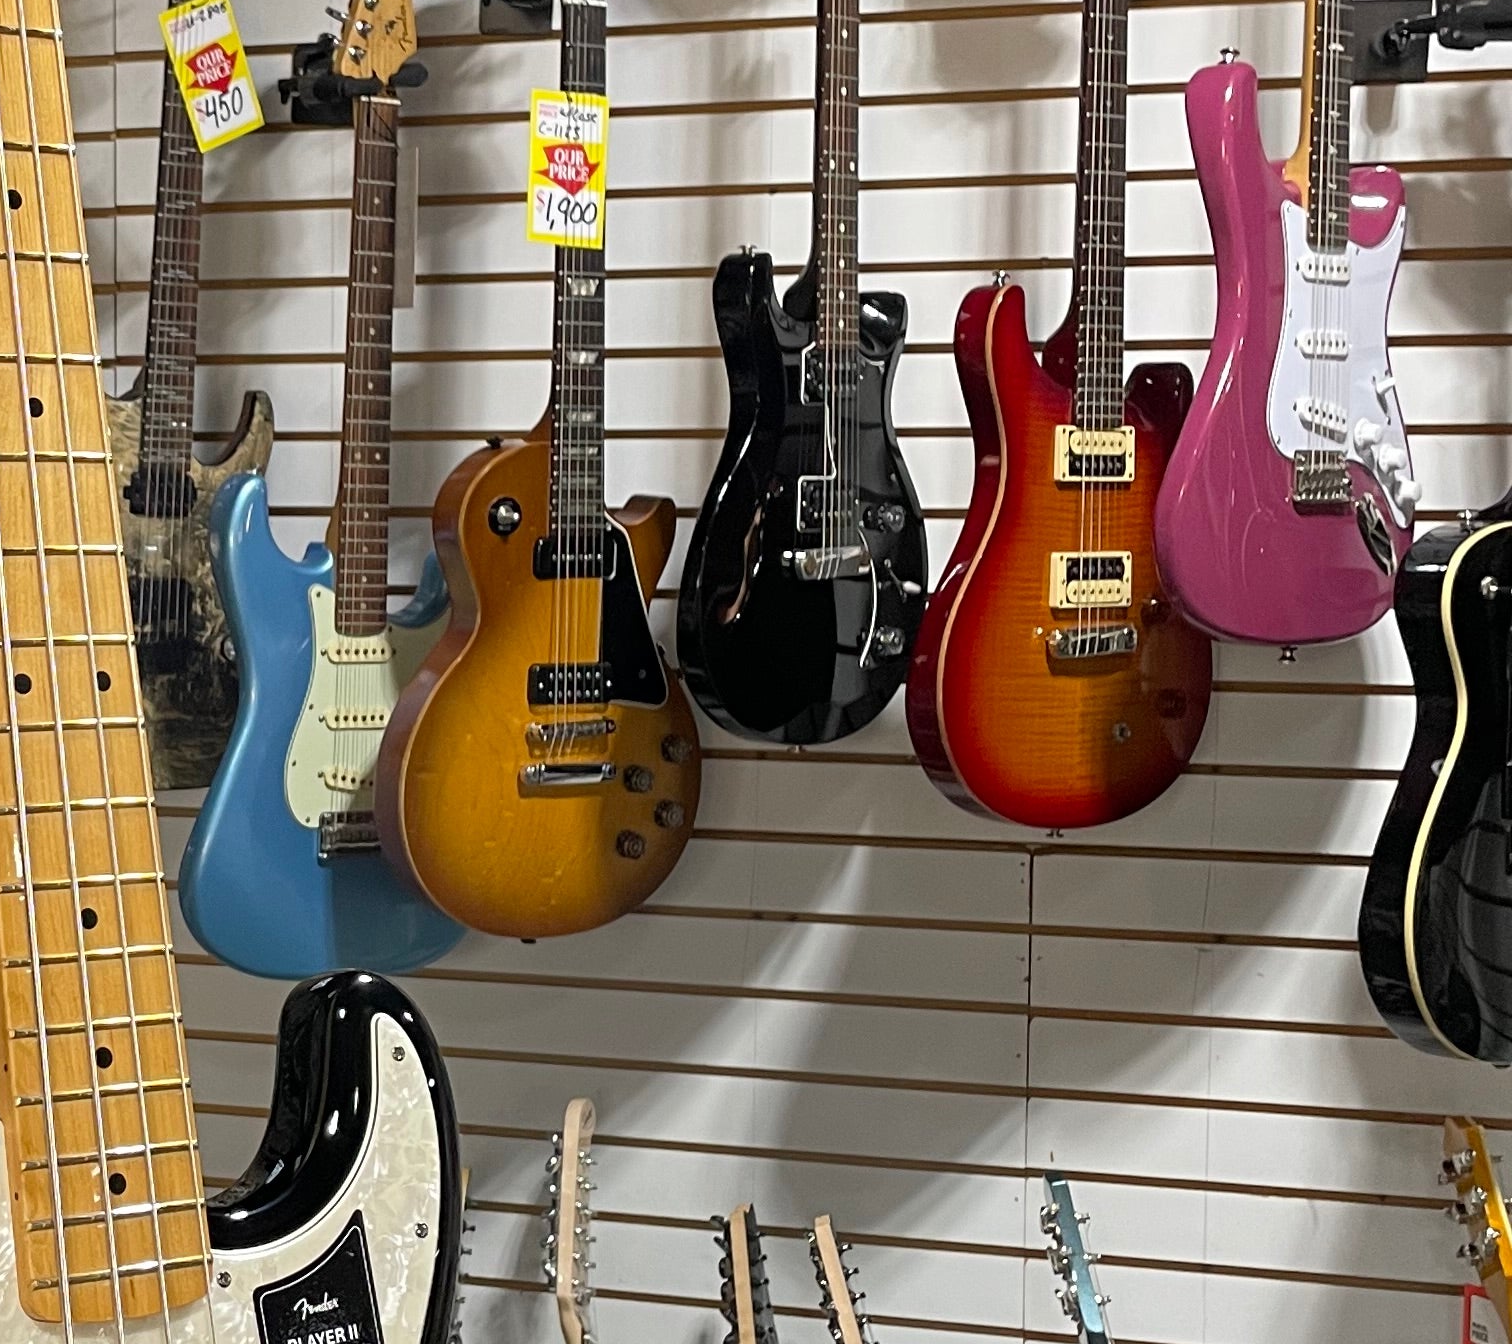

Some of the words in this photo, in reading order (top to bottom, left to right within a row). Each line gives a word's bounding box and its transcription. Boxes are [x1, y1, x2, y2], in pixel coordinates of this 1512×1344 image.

[195, 47, 226, 72] OUR
[196, 59, 233, 88] PRICE
[194, 86, 244, 129] $450
[553, 147, 585, 167] OUR
[548, 162, 590, 184] PRICE
[536, 191, 598, 231] $1,900
[293, 1291, 340, 1321] Fender
[348, 1323, 359, 1340] II
